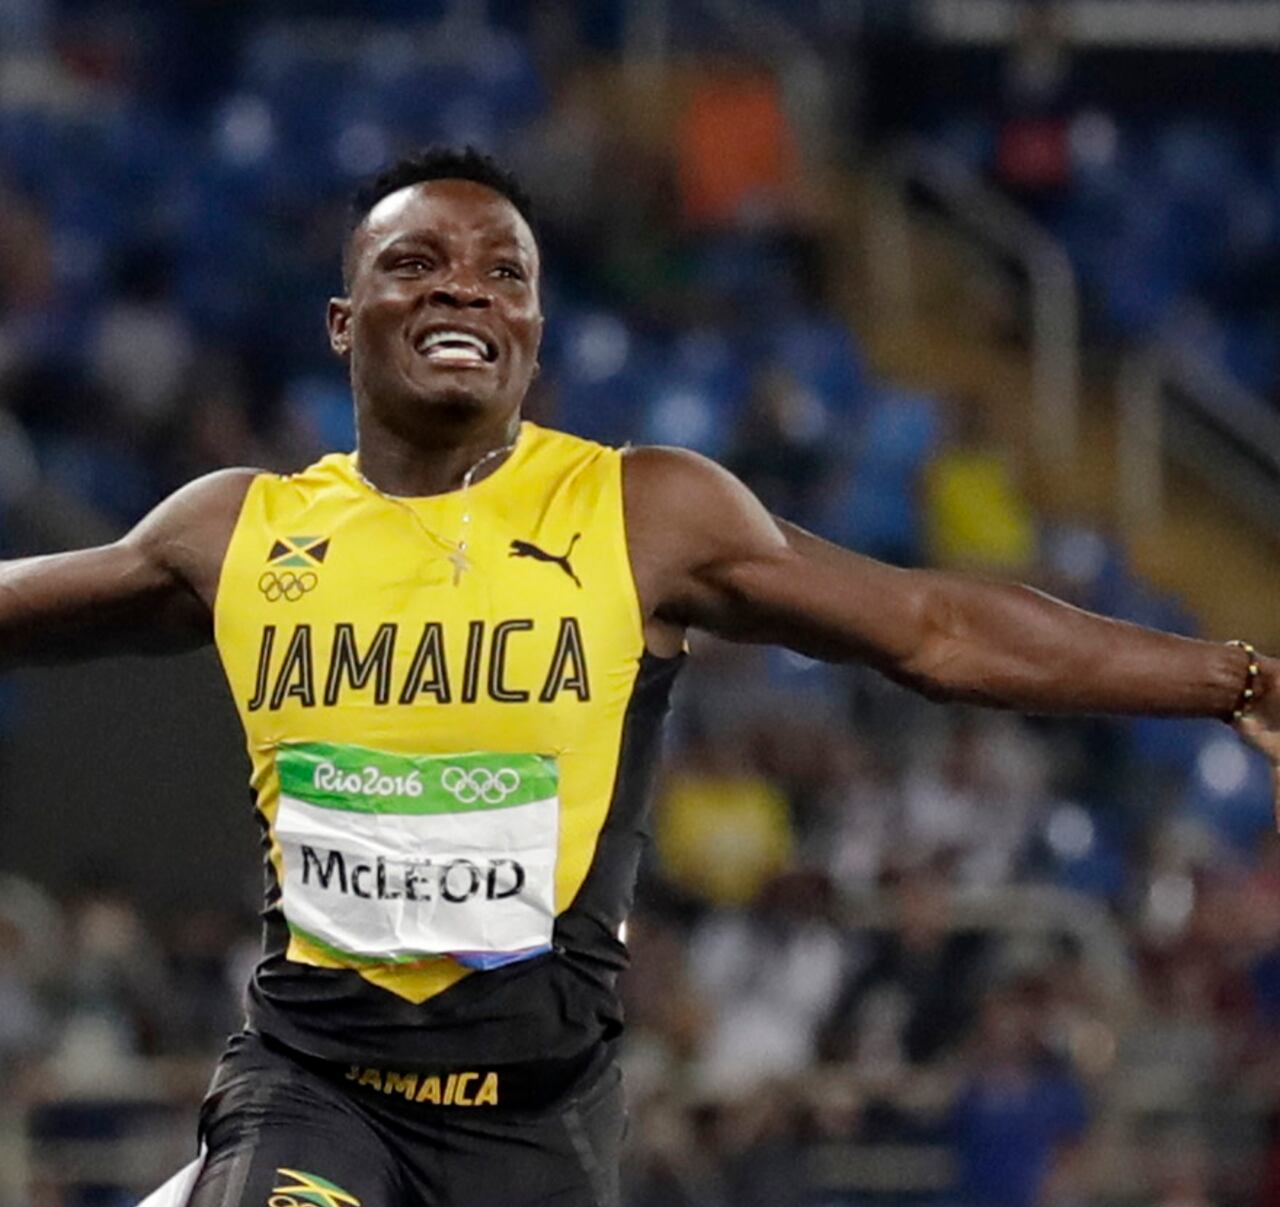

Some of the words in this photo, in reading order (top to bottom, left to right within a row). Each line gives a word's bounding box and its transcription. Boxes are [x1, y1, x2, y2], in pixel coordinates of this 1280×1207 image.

[248, 617, 591, 711] JAMAICA
[313, 762, 423, 797] Rio2016
[300, 845, 525, 903] McLEOD
